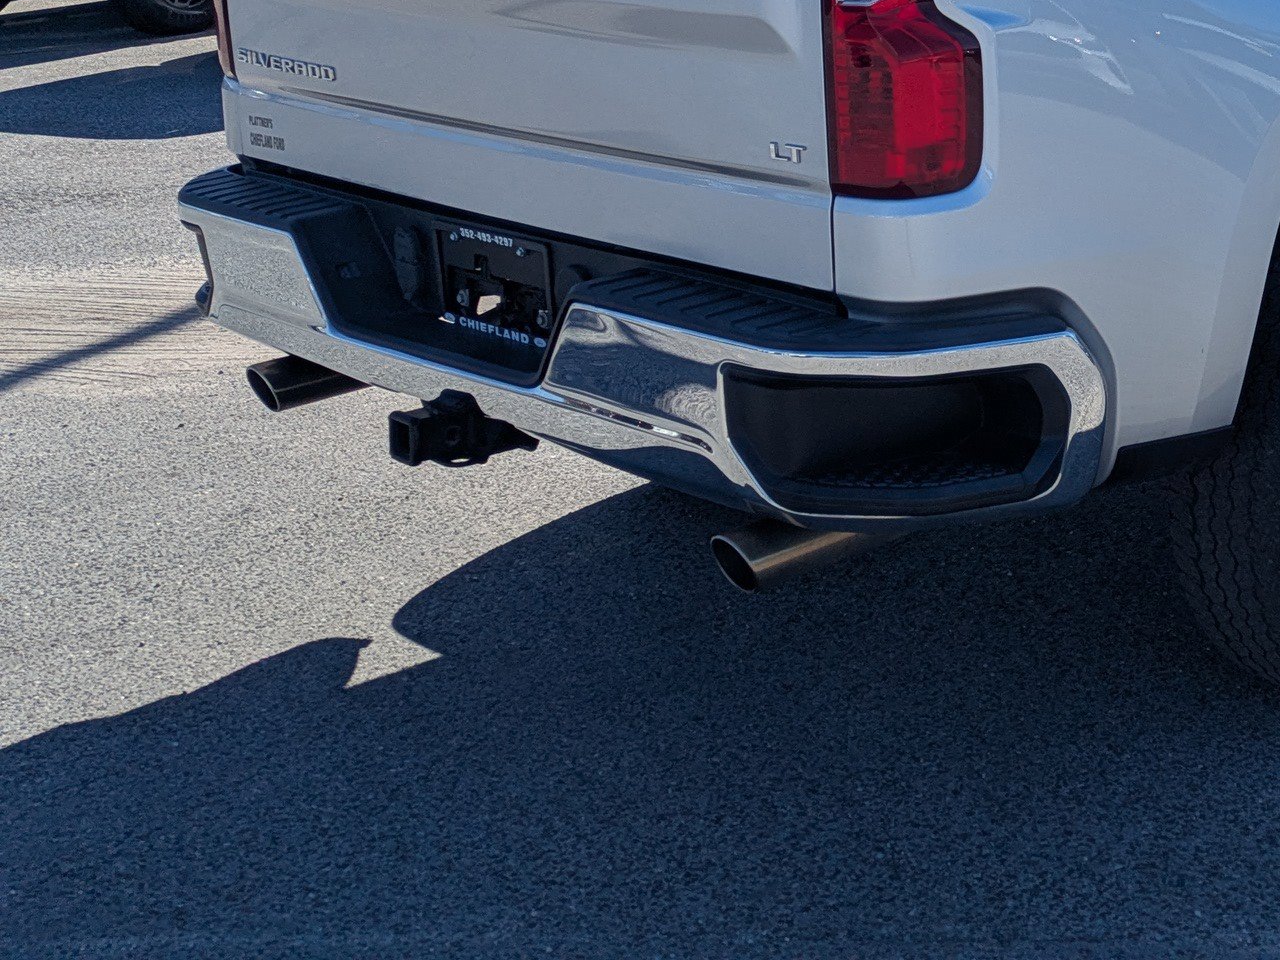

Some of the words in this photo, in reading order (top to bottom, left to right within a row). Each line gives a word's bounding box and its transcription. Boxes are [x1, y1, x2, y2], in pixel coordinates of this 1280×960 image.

[238, 47, 337, 81] SILVERADO
[769, 141, 807, 163] LT
[460, 228, 513, 247] 352-493-4297
[459, 316, 530, 344] CHIEFLAND
